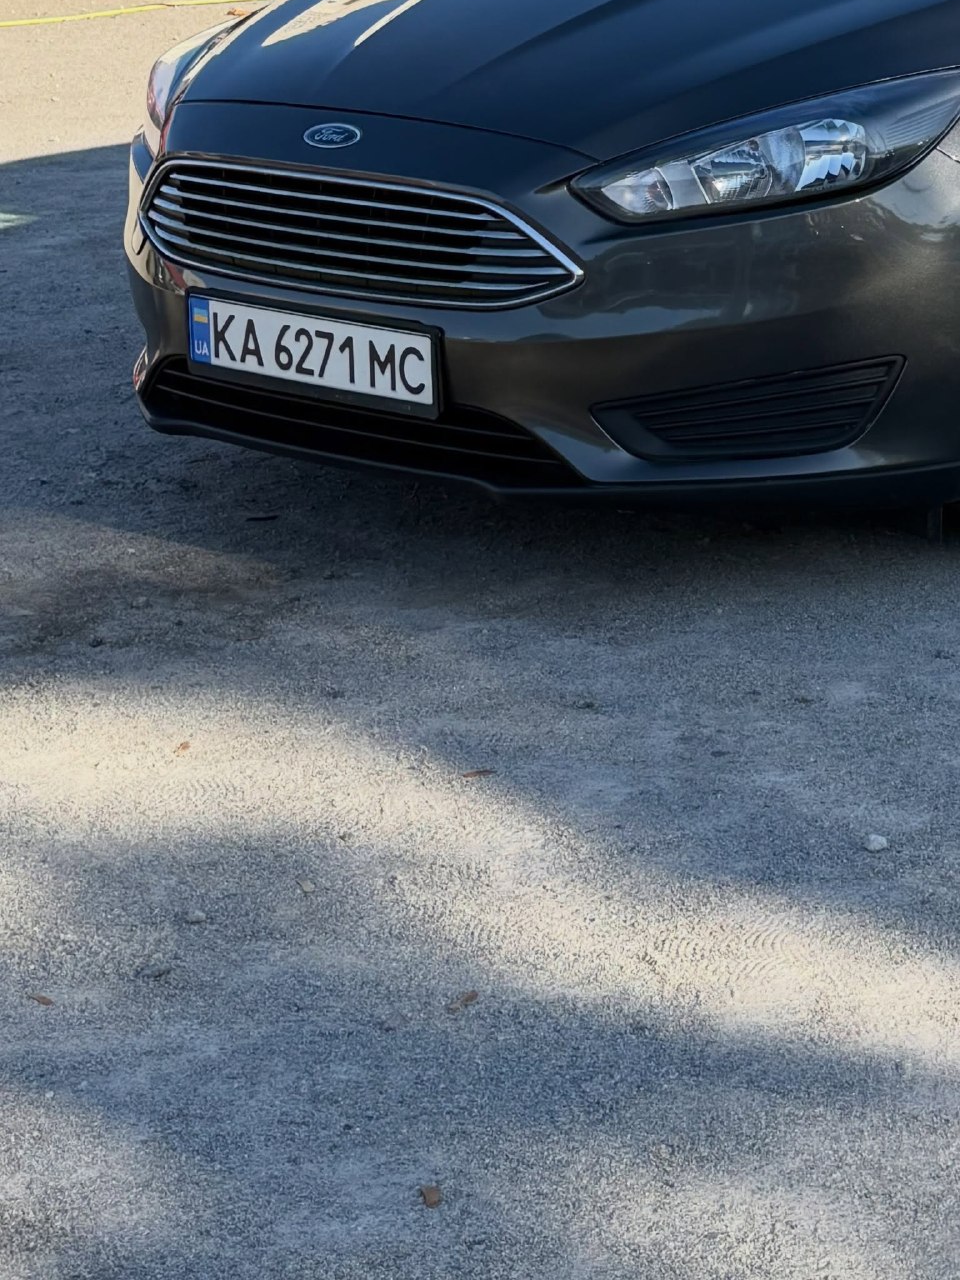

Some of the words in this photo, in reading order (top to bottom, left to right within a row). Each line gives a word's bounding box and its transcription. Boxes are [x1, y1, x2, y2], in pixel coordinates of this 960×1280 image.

[315, 127, 349, 142] Ford
[194, 339, 210, 356] UA
[212, 311, 264, 367] KA
[274, 324, 356, 384] 6271
[368, 339, 426, 395] MC
